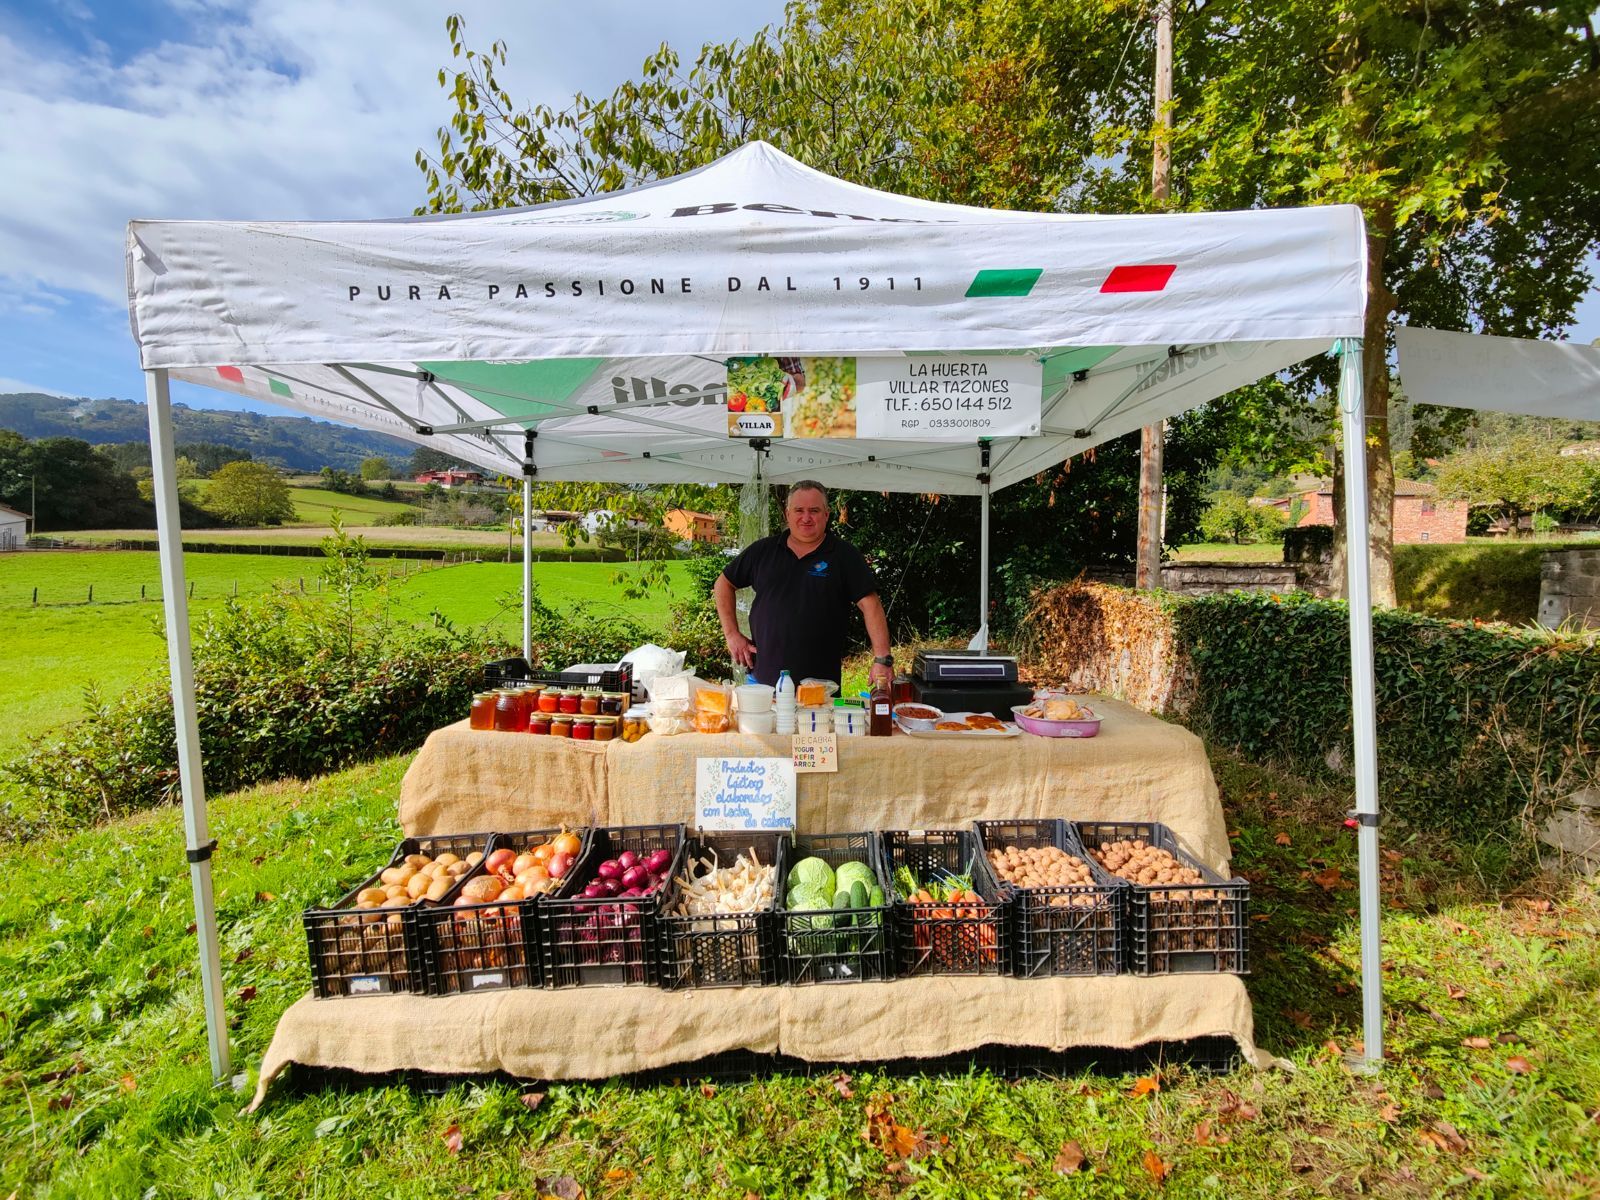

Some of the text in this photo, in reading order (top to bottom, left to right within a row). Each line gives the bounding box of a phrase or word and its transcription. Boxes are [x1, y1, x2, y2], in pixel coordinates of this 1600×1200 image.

[349, 276, 922, 301] PURA PASSIONE DAL 1911
[909, 363, 988, 377] LA HUERTA
[889, 379, 1009, 394] VILLAR TAZONES
[739, 422, 772, 430] VILLAR
[901, 419, 920, 428] RGP
[796, 735, 832, 745] DE CABRA
[794, 753, 815, 761] KEFIR
[722, 760, 766, 775] Productos
[703, 807, 720, 818] con
